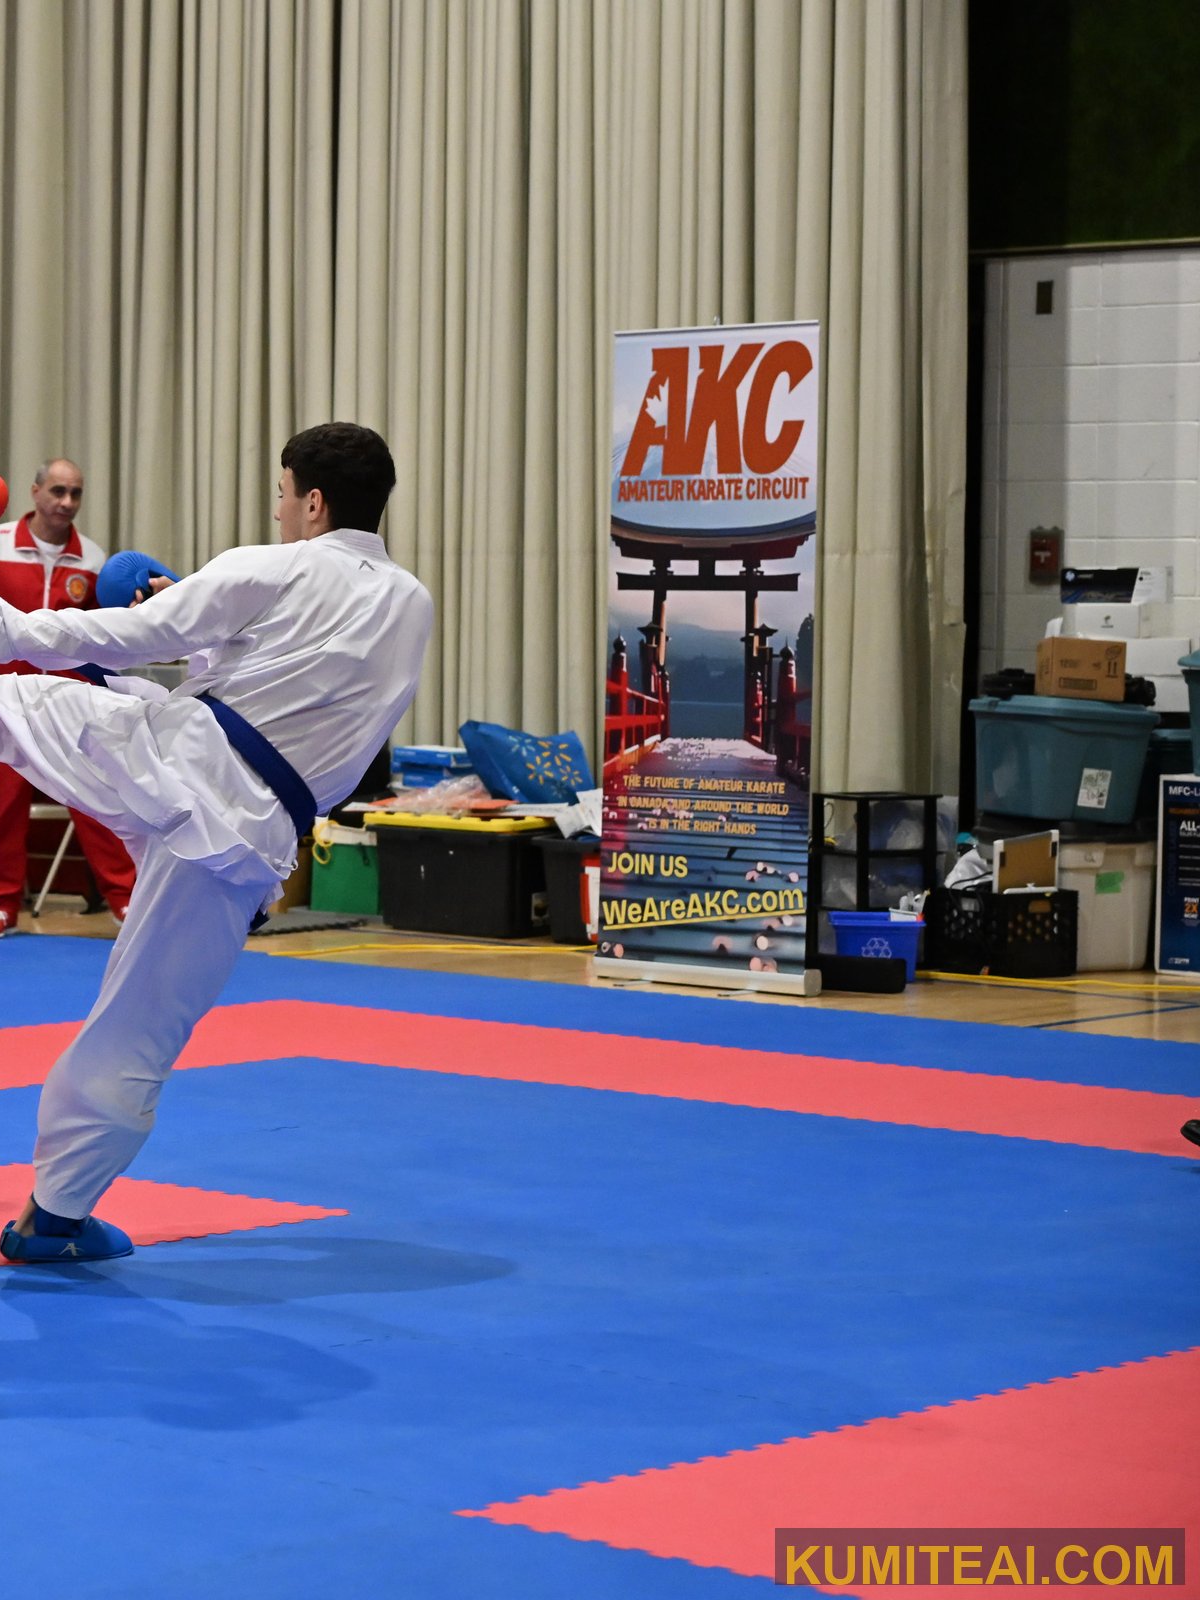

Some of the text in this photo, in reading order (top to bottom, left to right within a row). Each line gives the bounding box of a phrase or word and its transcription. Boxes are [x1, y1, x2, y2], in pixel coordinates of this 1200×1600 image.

[620, 340, 813, 477] AKC
[618, 477, 809, 502] AMATEUR KARATE CIRCUIT
[623, 775, 786, 794] THE FUTURE OF AMATEUR KARATE
[1168, 786, 1200, 797] MFC-L
[617, 795, 789, 816] IN CANADA AND AROUND THE WORLD
[648, 819, 756, 835] IS IN THE RIGHT HANDS
[608, 852, 688, 878] JOIN US
[602, 888, 804, 925] WeAreAKC.com
